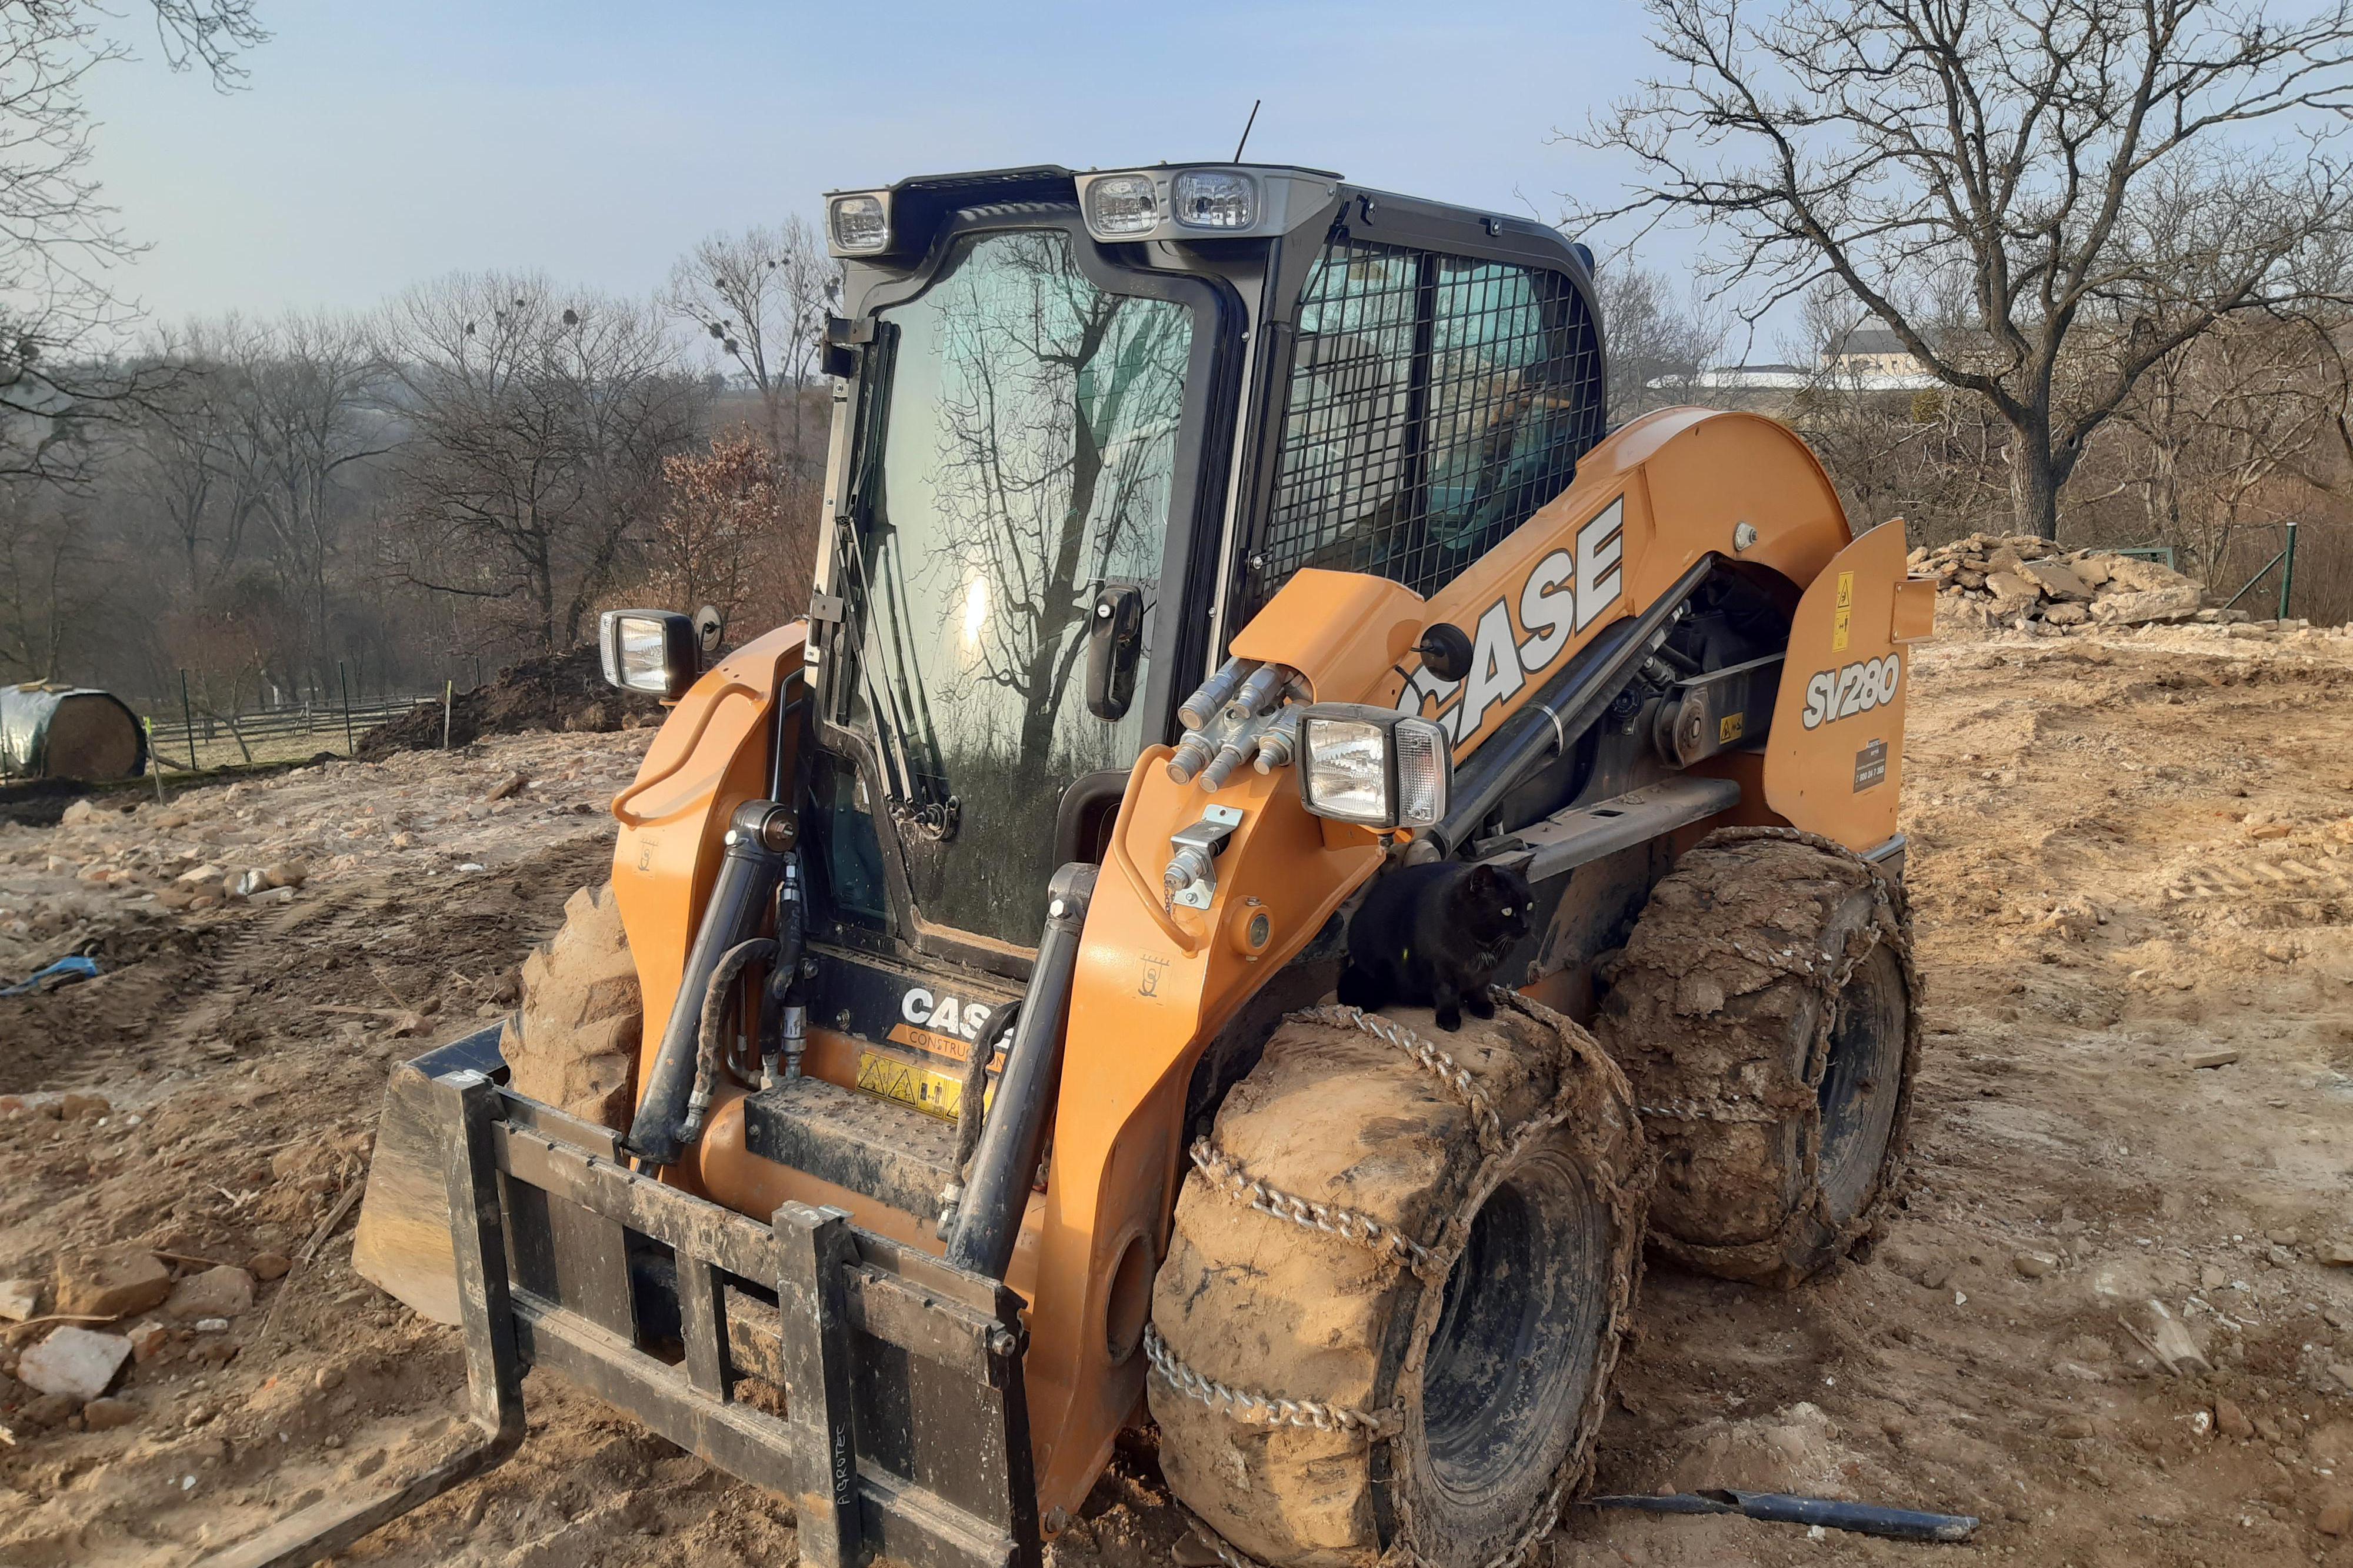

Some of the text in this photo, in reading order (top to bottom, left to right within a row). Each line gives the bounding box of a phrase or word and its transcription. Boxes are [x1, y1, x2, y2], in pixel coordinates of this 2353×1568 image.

[1802, 652, 1901, 730] SV280
[902, 987, 1014, 1049] CAS
[835, 1421, 851, 1506] AGROTEC
